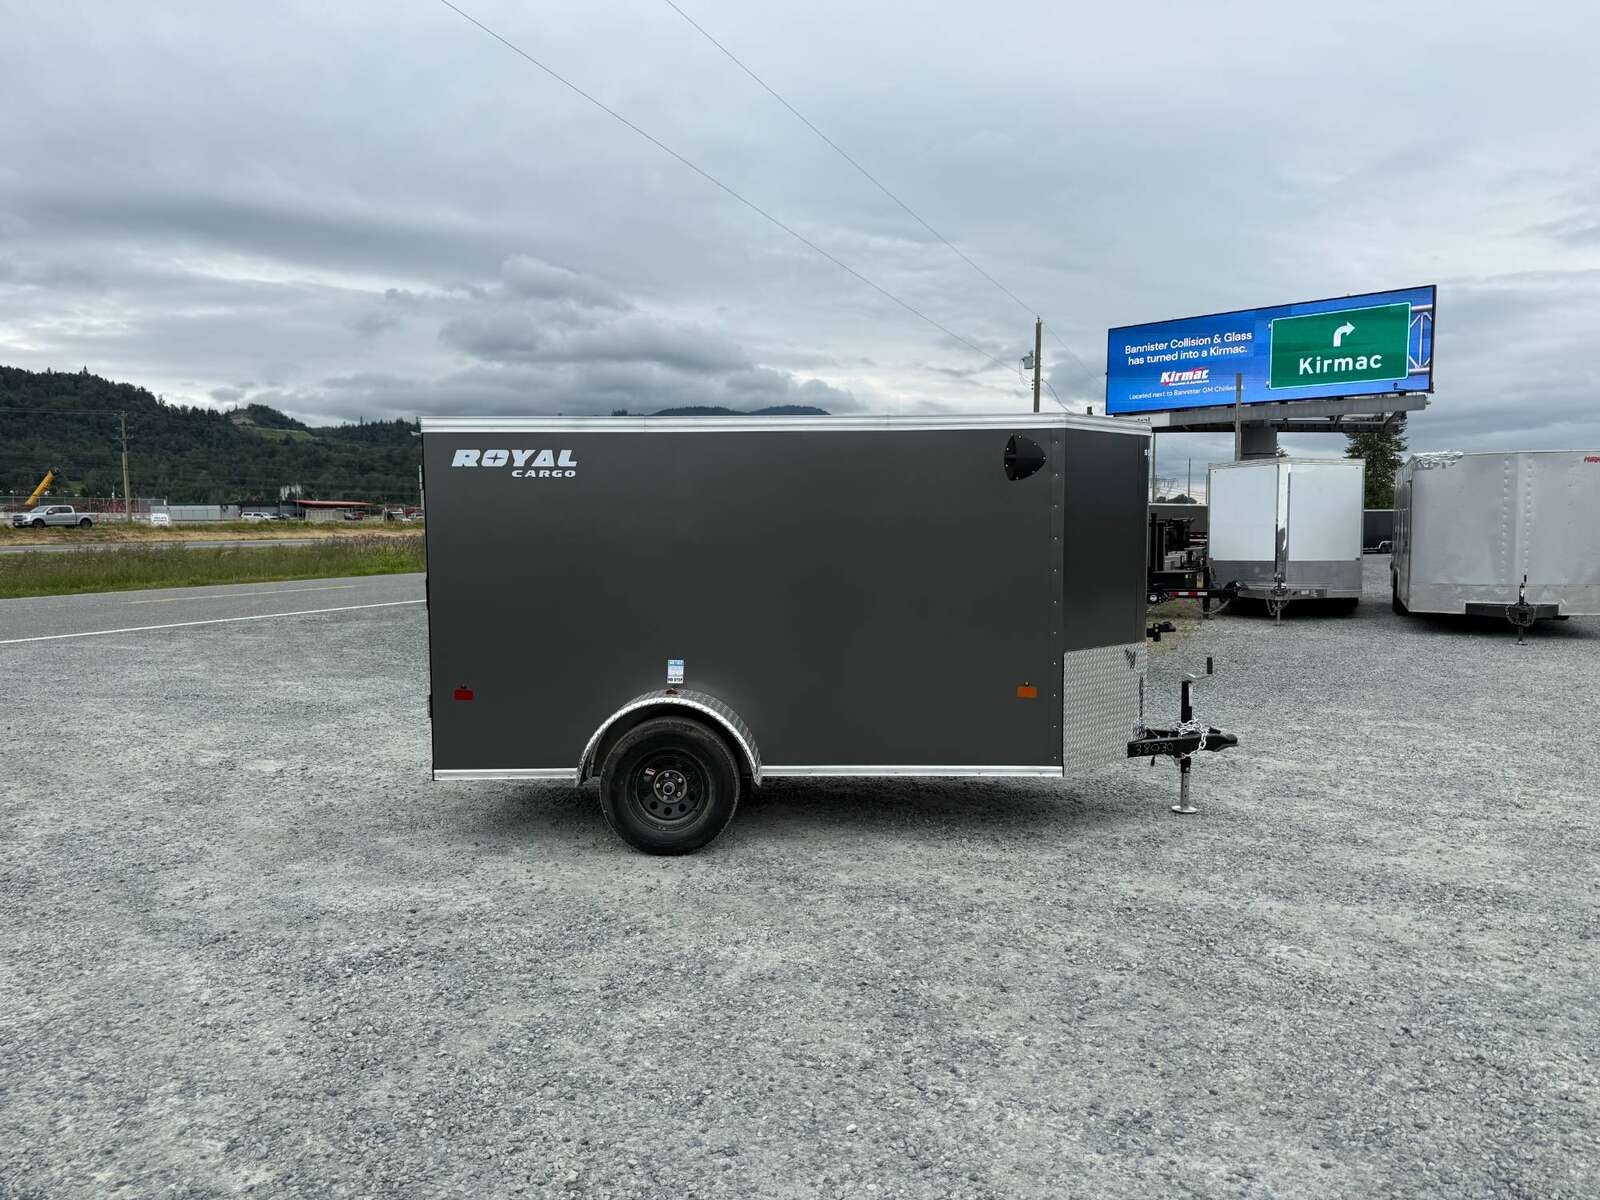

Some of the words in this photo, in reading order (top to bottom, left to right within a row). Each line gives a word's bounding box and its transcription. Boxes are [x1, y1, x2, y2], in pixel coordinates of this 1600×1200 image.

[1125, 342, 1169, 355] Bannister
[1170, 336, 1211, 349] Collision
[1213, 334, 1222, 344] &
[1224, 332, 1253, 342] Glass
[1128, 356, 1145, 365] has
[1147, 351, 1178, 363] turned
[1180, 350, 1199, 360] into
[1201, 350, 1208, 358] a
[1210, 345, 1248, 356] Kirmac.
[1299, 354, 1382, 375] Kirmac
[1160, 369, 1210, 383] Kirmac
[1129, 392, 1152, 400] Located
[452, 449, 577, 467] ROYAL
[511, 470, 577, 478] CARGO
